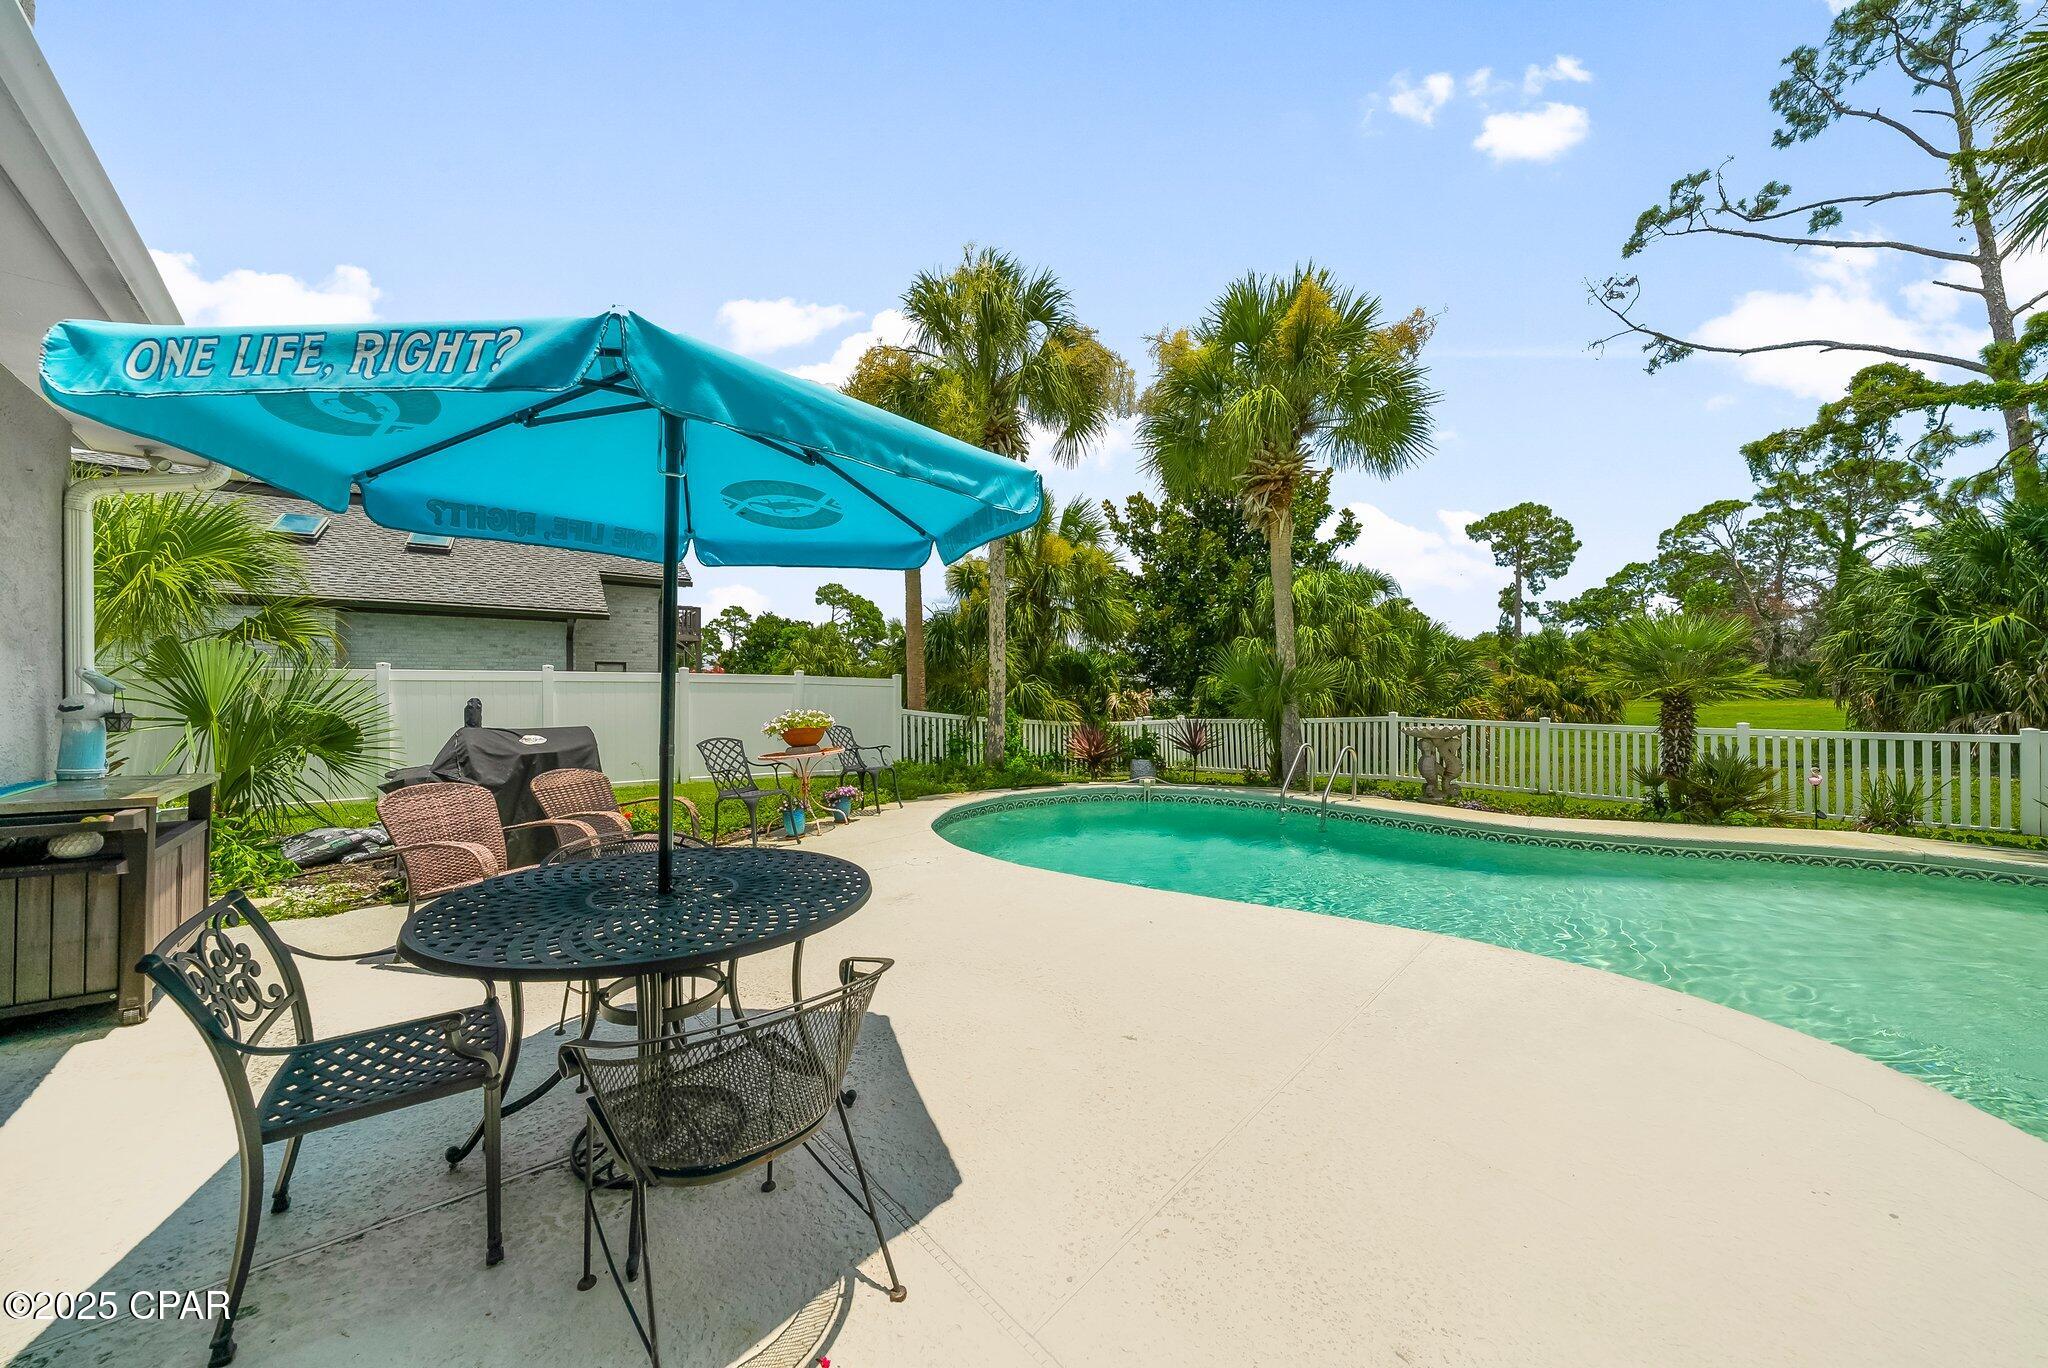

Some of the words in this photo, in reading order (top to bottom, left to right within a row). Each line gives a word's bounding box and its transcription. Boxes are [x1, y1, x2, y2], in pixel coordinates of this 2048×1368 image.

[125, 335, 220, 382] ONE
[229, 331, 334, 380] LIFE,
[349, 326, 524, 380] RIGHT?
